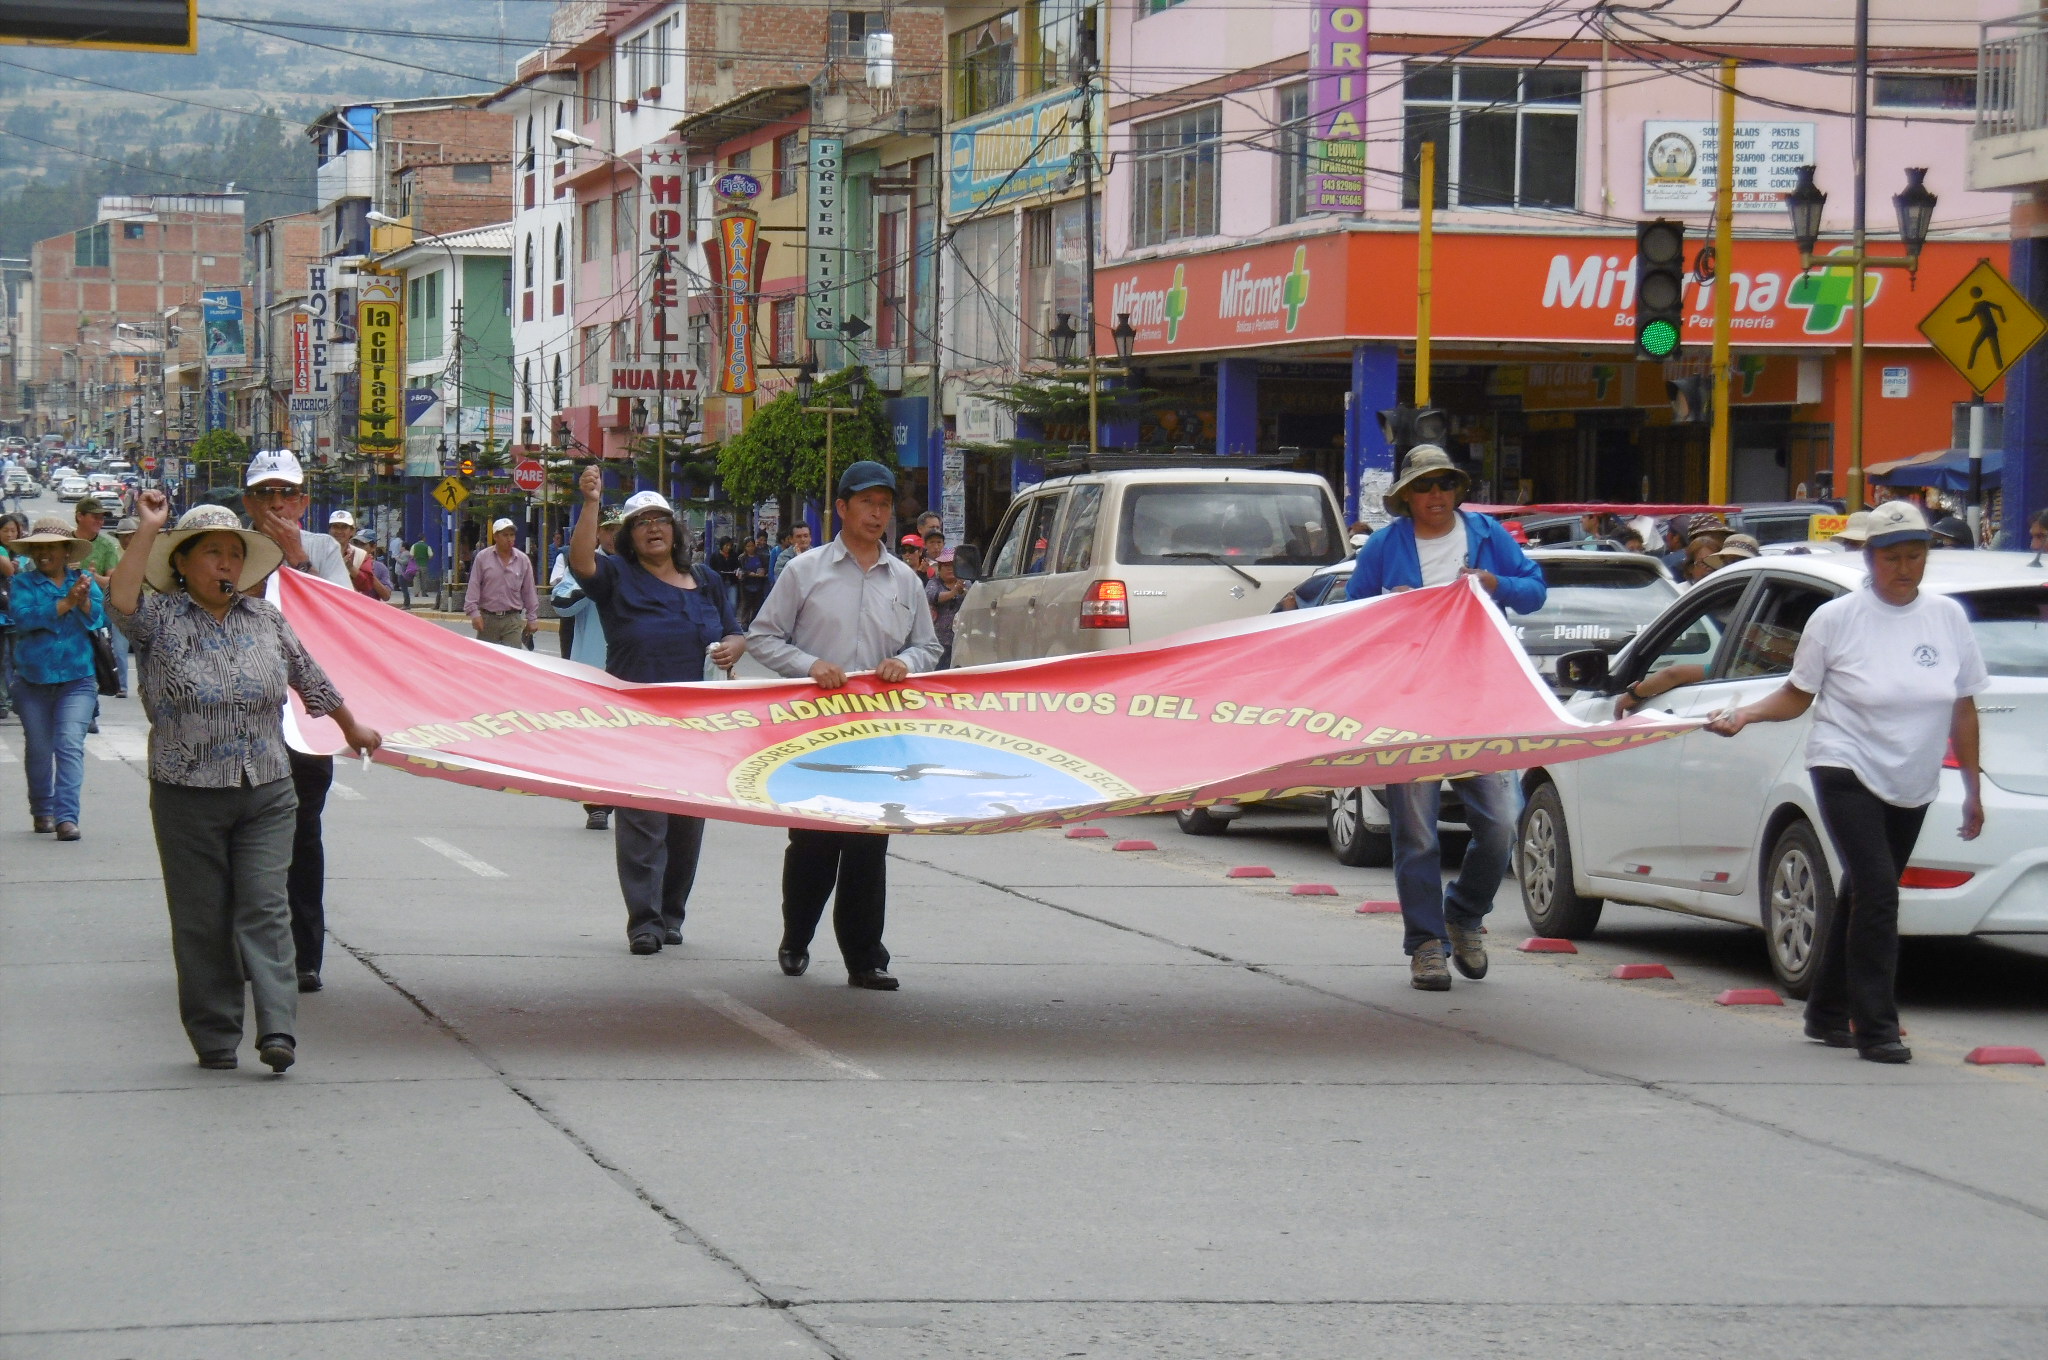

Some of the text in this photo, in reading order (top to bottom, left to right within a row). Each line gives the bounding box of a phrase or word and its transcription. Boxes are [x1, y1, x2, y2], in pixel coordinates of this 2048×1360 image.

[1311, 8, 1320, 137] ORIA
[1330, 8, 1364, 136] ORIA
[1702, 128, 1718, 136] SOU
[1771, 128, 1800, 137] PASTAS
[972, 111, 1034, 184] HUARAZ
[1327, 143, 1357, 158] EDWIN
[1771, 141, 1799, 149] PIZZAS
[1735, 153, 1765, 163] SEAFOOD
[1771, 154, 1804, 163] CHICKEN
[1742, 167, 1757, 175] AND
[720, 178, 757, 193] Fiesta
[1739, 179, 1757, 188] MORE
[1770, 179, 1796, 188] COCKT
[1743, 193, 1753, 201] 50
[730, 222, 747, 274] SALA
[816, 145, 836, 331] FOREVER LIVING
[650, 175, 681, 341] HOTEL
[732, 279, 746, 305] DE
[1219, 262, 1283, 319] Mifarma
[1110, 276, 1164, 328] Mifarma
[366, 307, 391, 327] la
[310, 268, 328, 392] HOTEL
[296, 323, 308, 387] MILITAS
[730, 311, 747, 388] JUEGOS
[612, 368, 698, 391] HUARAZ
[291, 398, 329, 411] AMERICA
[515, 469, 543, 482] PARE
[1554, 624, 1610, 640] Patilla
[769, 688, 1117, 725] ADMINISTRATIVOS
[1127, 693, 1199, 721] DEL
[1210, 701, 1364, 742] SECTOR
[735, 743, 805, 795] TRABAJADORES
[806, 721, 1048, 756] ADMINISTRATIVOS
[1047, 753, 1083, 774] DEL
